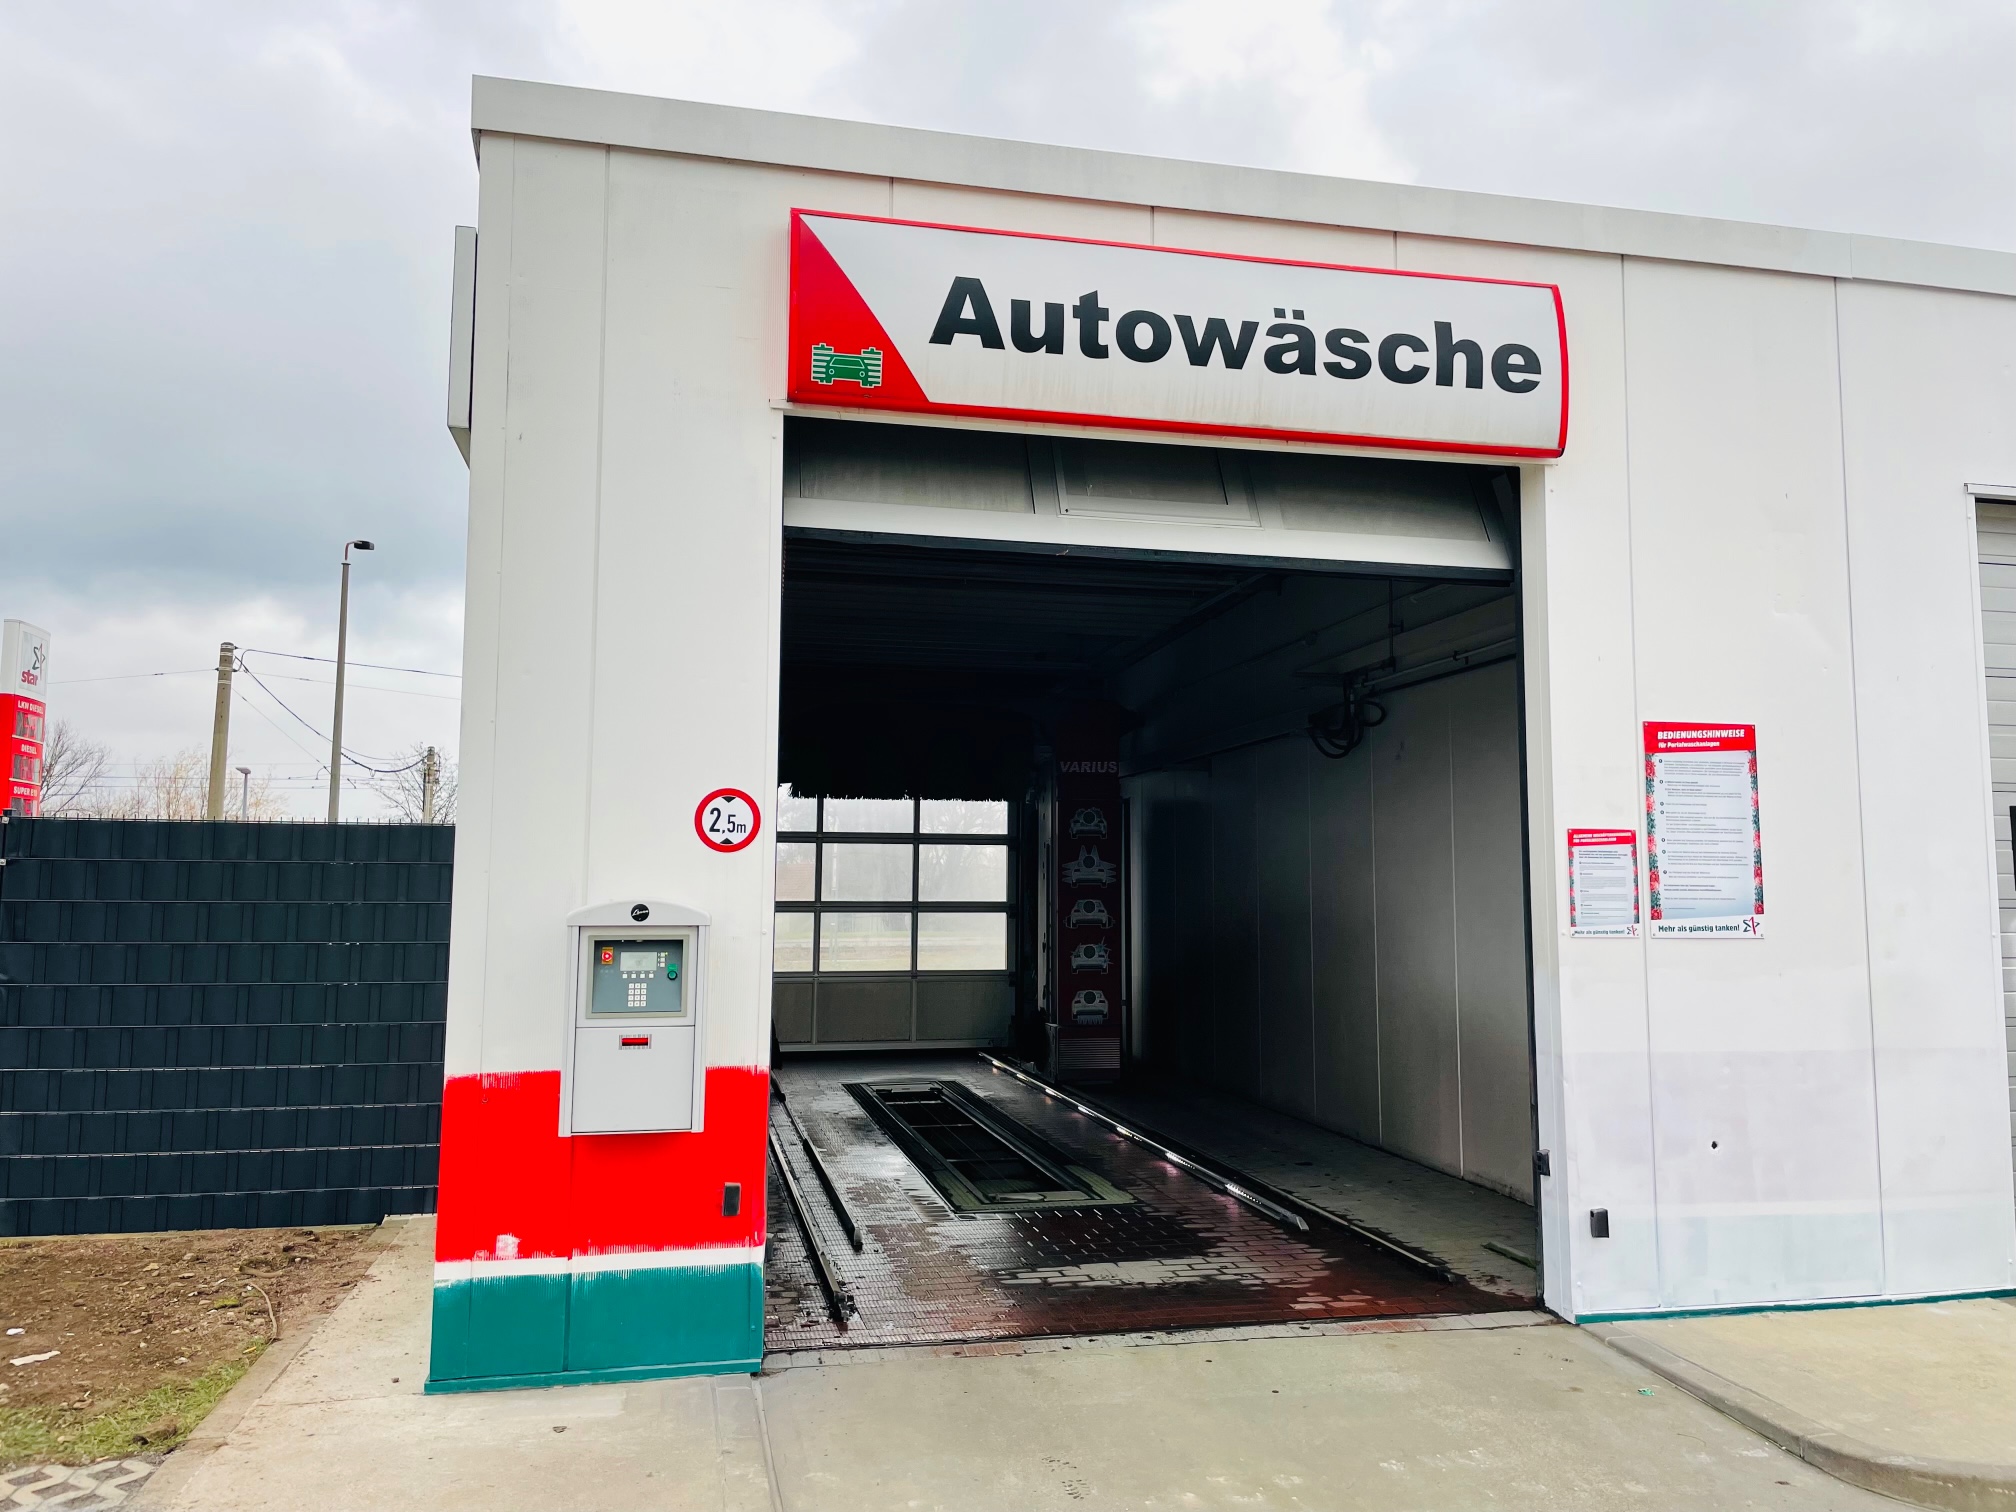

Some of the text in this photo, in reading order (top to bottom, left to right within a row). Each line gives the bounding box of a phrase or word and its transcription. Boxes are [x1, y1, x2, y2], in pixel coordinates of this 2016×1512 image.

[928, 275, 1542, 394] Autowäsche
[21, 669, 38, 686] star
[17, 700, 43, 714] LKW DIESEL
[1657, 728, 1745, 740] BEDIENUNGSHINWEISE
[21, 743, 37, 755] DIESEL
[1667, 740, 1720, 748] Portalwaschanlagen
[1060, 761, 1118, 773] VARIUS
[13, 785, 30, 796] SUPER
[1658, 925, 1675, 933] Mehr
[1688, 924, 1714, 934] günstig
[1715, 924, 1740, 932] tanken!
